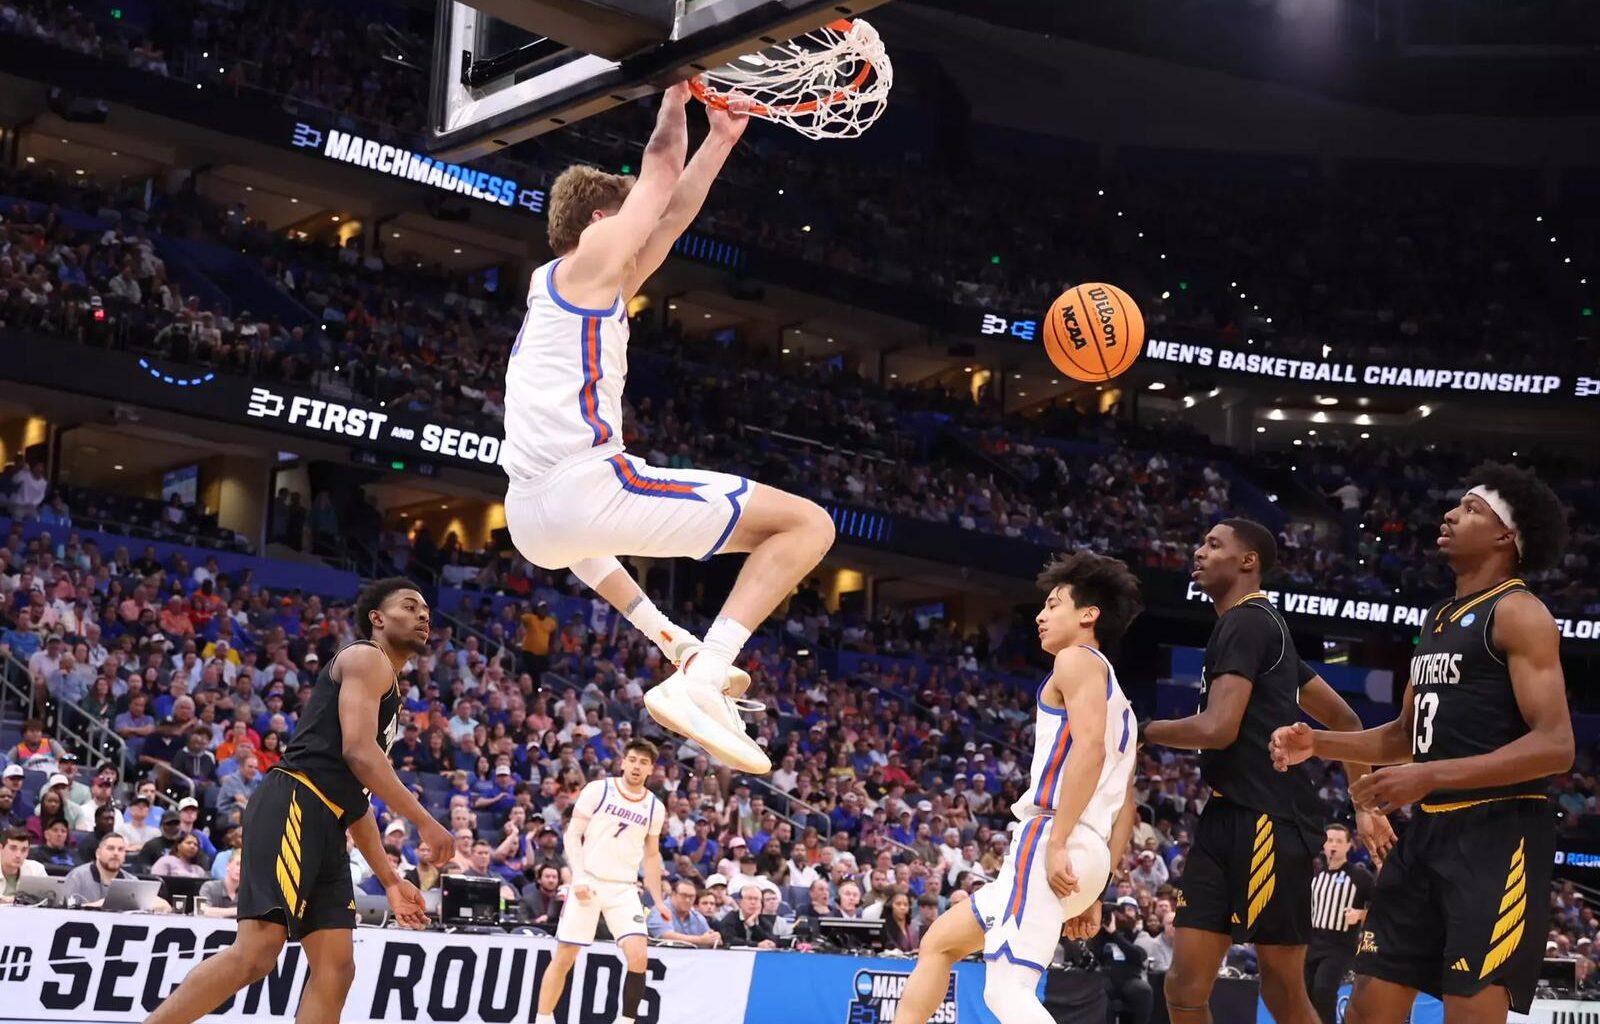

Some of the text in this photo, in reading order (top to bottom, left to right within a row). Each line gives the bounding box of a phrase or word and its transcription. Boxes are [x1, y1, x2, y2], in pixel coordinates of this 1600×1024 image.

[324, 129, 517, 207] MARCHMADNESS
[1062, 305, 1087, 350] NCAA
[1088, 287, 1117, 348] Wilson
[1146, 340, 1561, 394] MEN'S BASKETBALL CHAMPIONSHIP
[288, 396, 388, 440] FIRST
[391, 426, 415, 441] AND
[1284, 592, 1338, 617] VIEW
[1340, 600, 1388, 623] A&M
[1118, 707, 1130, 754] 1
[1412, 692, 1440, 755] 13
[604, 803, 648, 827] FLORIDA
[613, 822, 629, 838] 7
[40, 921, 311, 1018] SECN
